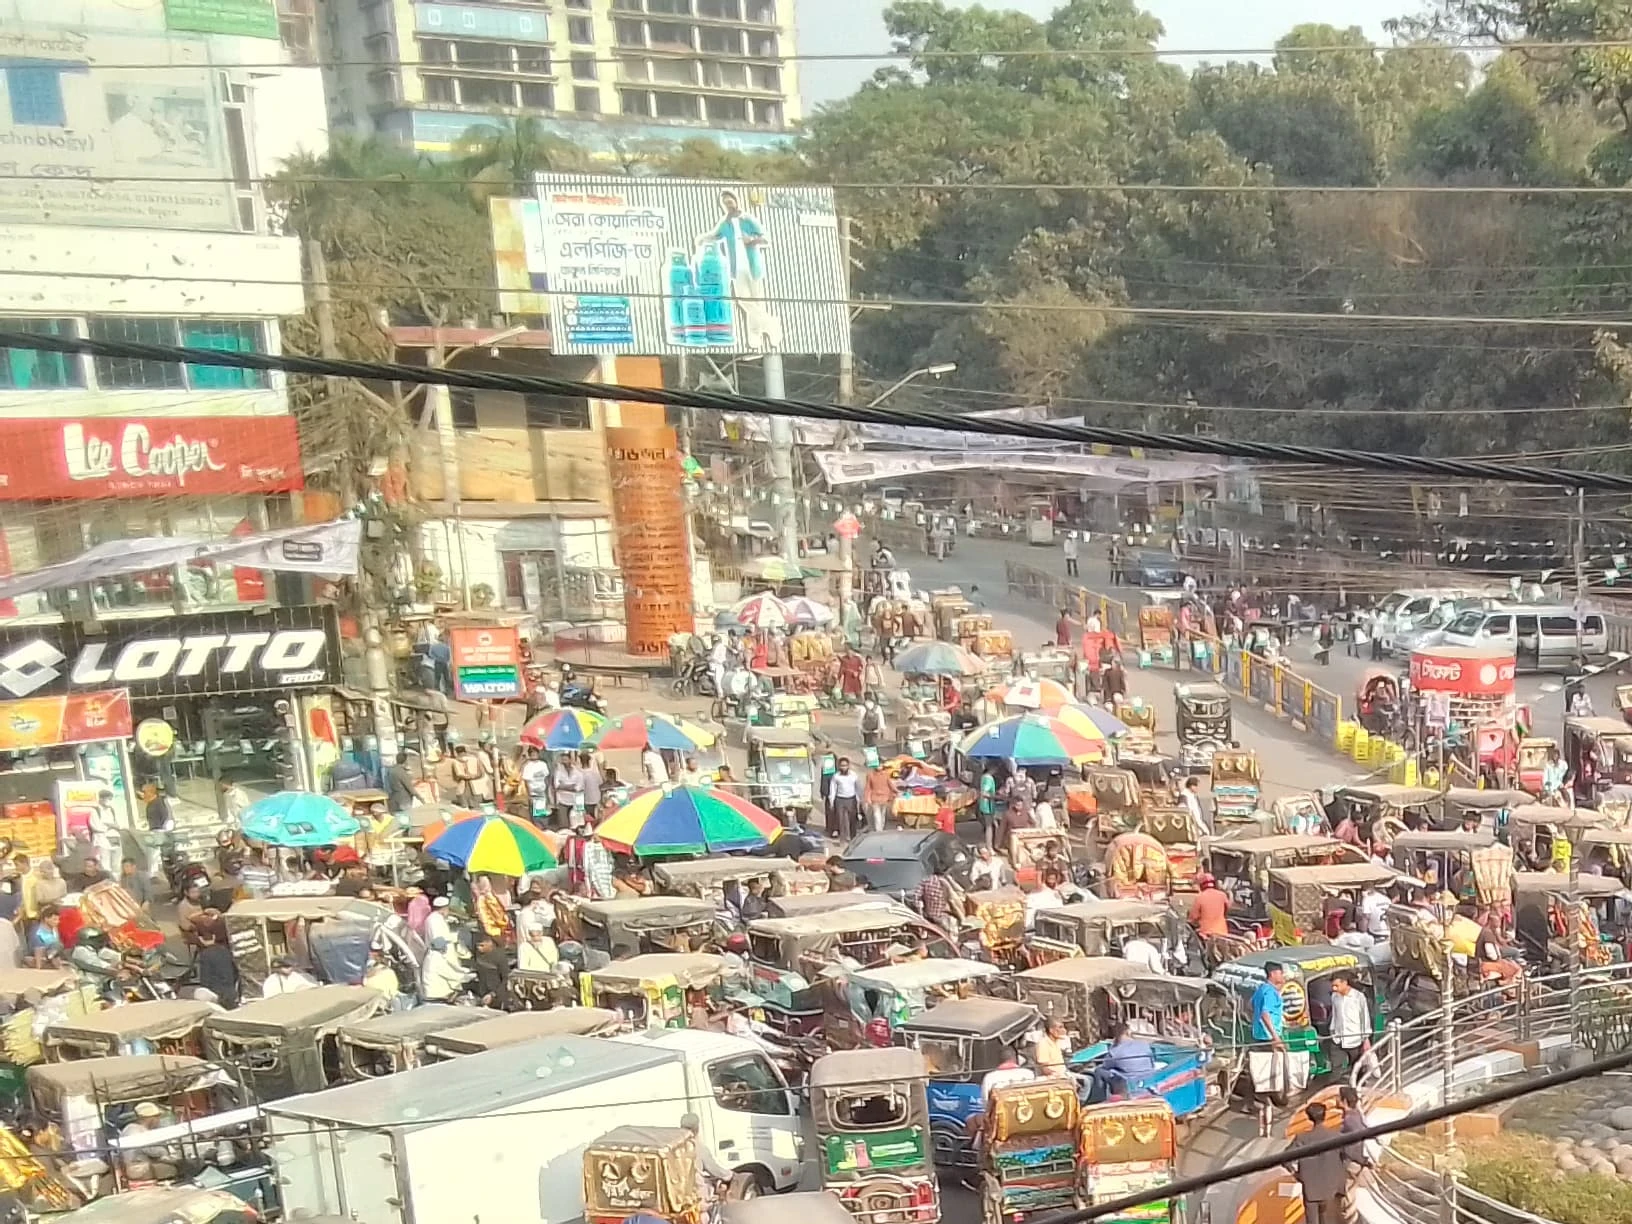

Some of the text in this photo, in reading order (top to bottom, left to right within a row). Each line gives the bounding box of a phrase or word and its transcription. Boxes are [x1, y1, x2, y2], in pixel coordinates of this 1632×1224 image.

[554, 212, 585, 228] সেরা
[64, 423, 225, 487] Lee Cooper
[72, 630, 327, 684] LOTTO
[463, 682, 515, 694] WALTON
